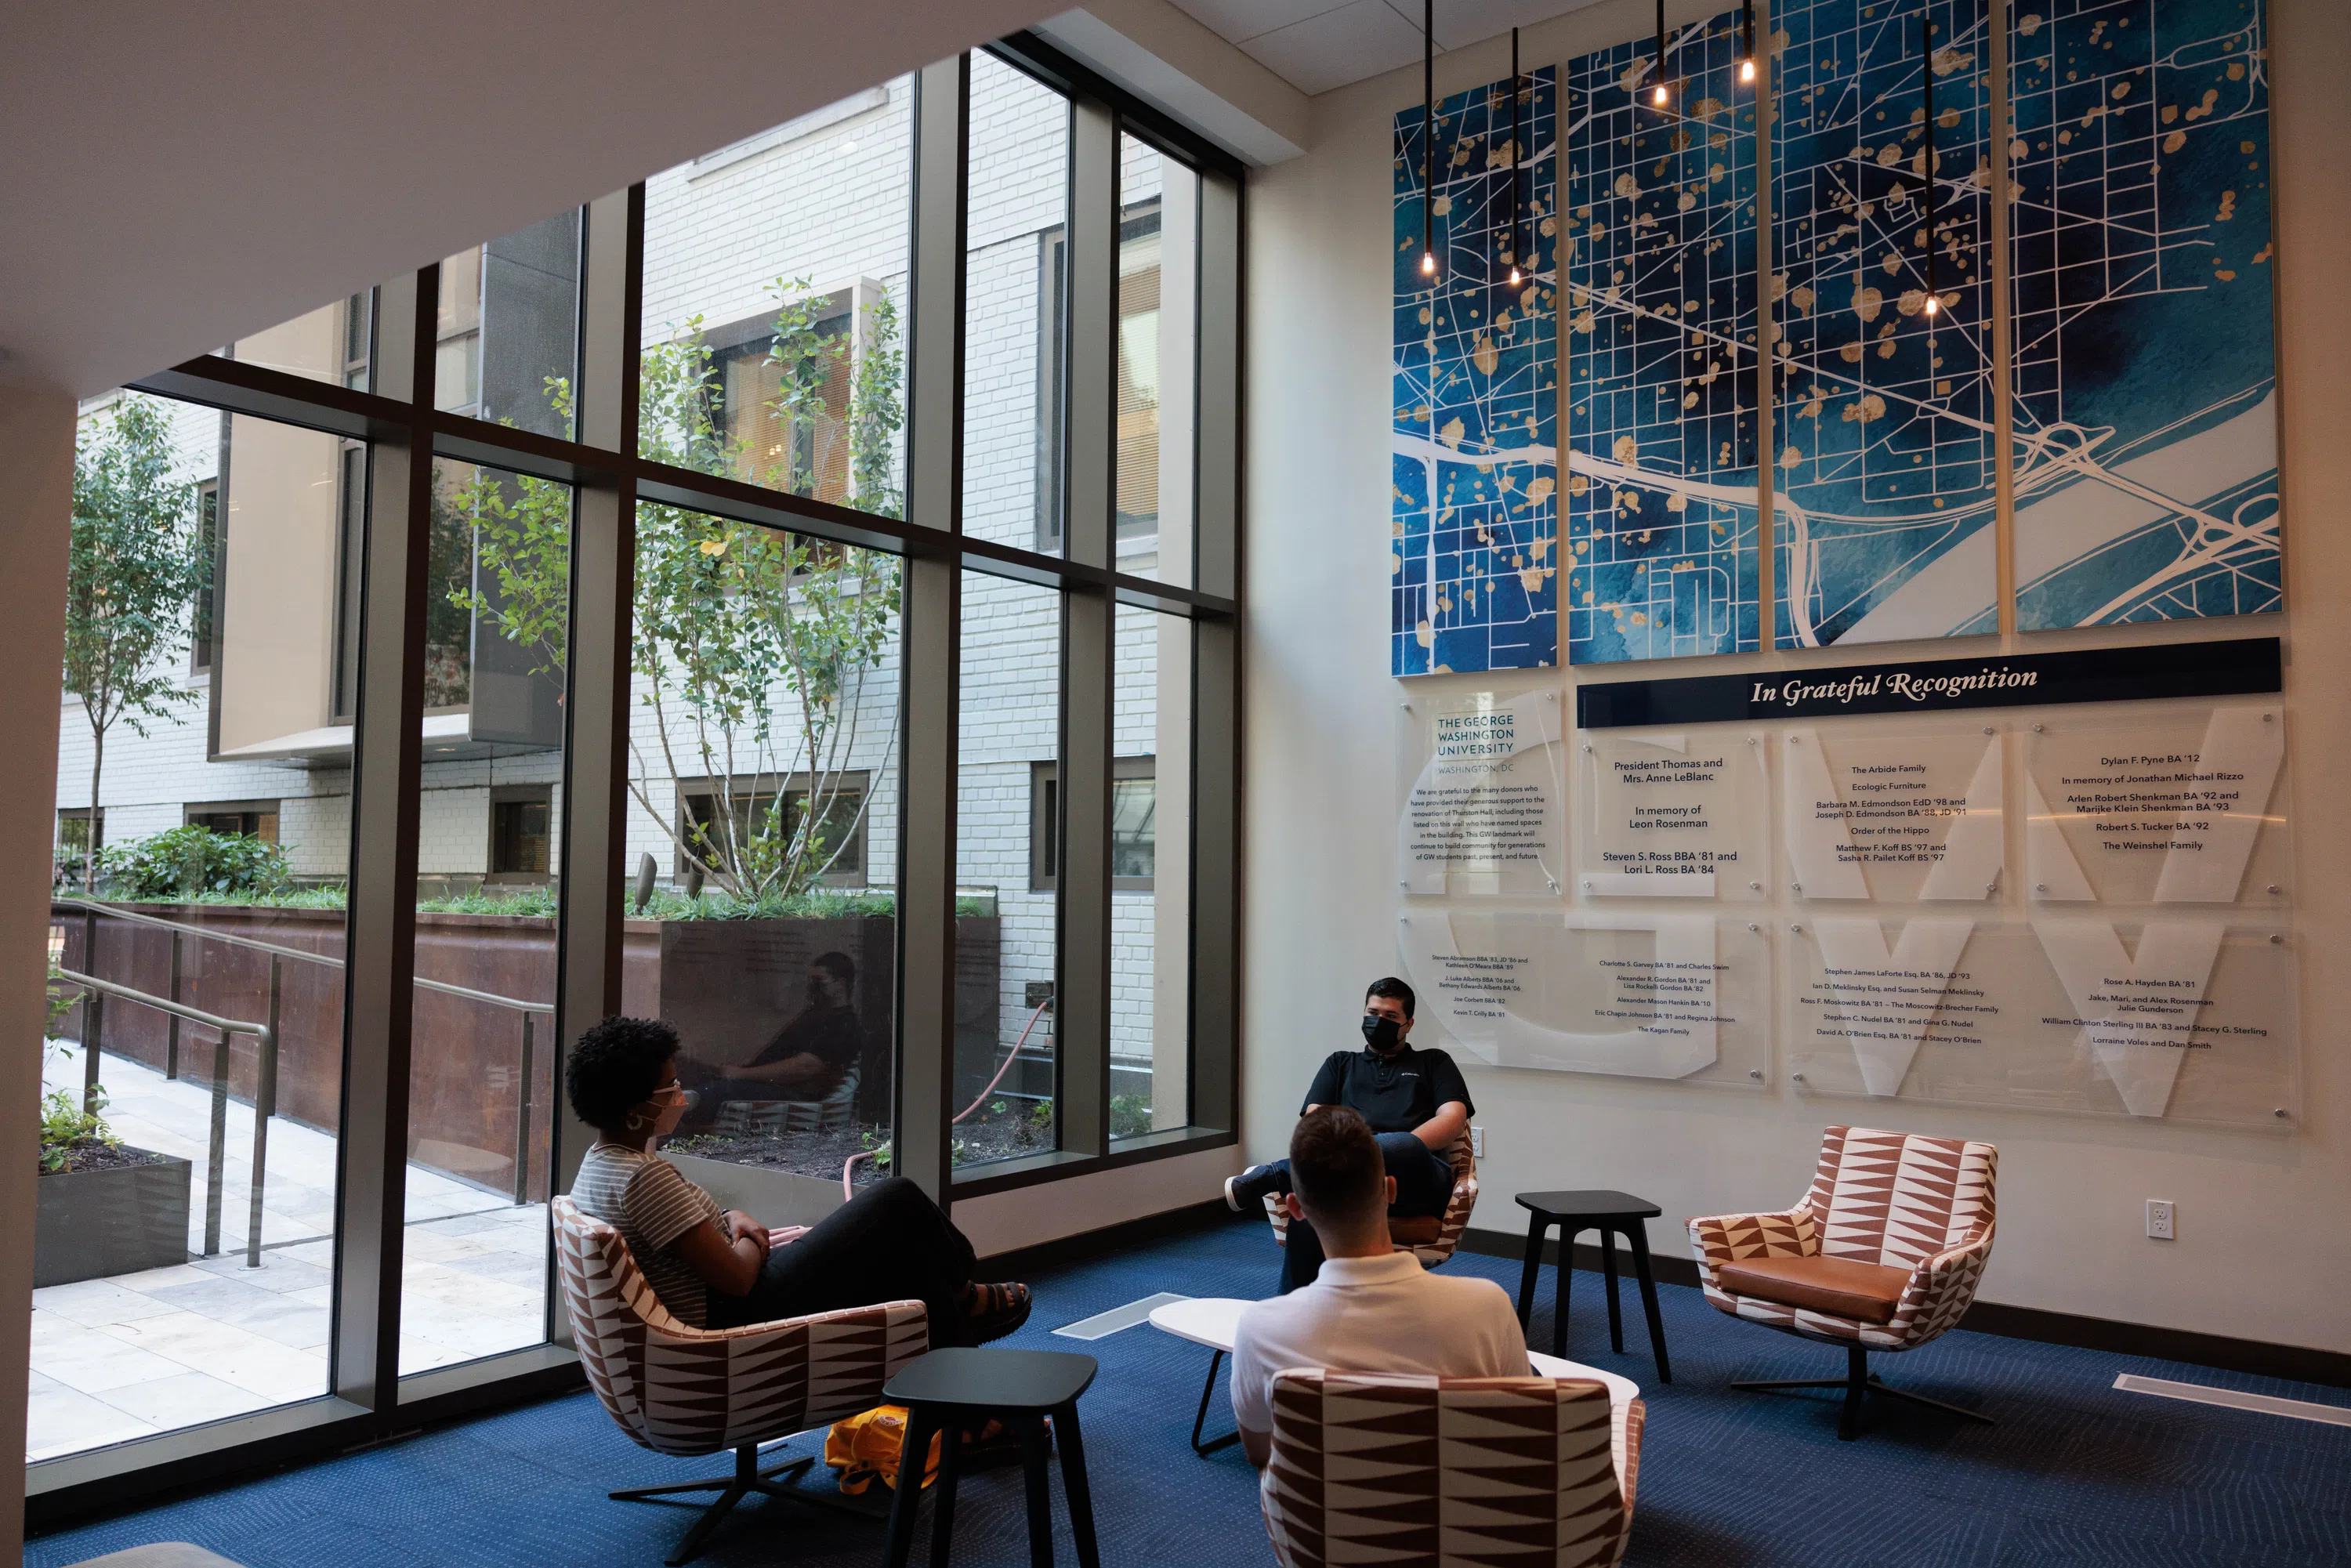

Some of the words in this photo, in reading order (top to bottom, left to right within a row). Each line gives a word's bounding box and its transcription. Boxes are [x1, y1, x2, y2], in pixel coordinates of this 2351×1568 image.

[1751, 683, 1777, 702] In
[1783, 675, 1882, 707] Grateful
[1886, 667, 2038, 701] Recognition
[1438, 719, 1461, 728] THE
[1464, 715, 1513, 727] GEORGE
[1438, 729, 1514, 742] WASHINGTON
[1439, 743, 1513, 756] UNIVERSITY
[1615, 761, 1660, 771] President
[1661, 760, 1701, 769] Thomas
[1704, 758, 1722, 768] and
[2101, 757, 2128, 767] Dylan
[2141, 756, 2164, 766] Pyne
[1439, 765, 1498, 774] WASHINGTON,
[1899, 765, 1926, 773] Family
[1624, 774, 1644, 783] Mrs.
[1646, 774, 1672, 783] Anne
[1675, 772, 1714, 782] LeBlanc
[2114, 775, 2125, 784] of
[2127, 774, 2172, 783] Jonathan
[2175, 773, 2214, 781] Michael
[1853, 784, 1887, 792] Ecologic
[2095, 794, 2127, 802] Robert
[2130, 793, 2181, 802] Shenkman
[2219, 791, 2239, 800] and
[1862, 799, 1911, 808] Edmondson
[1647, 808, 1689, 817] memory
[1691, 805, 1701, 814] of
[1816, 811, 1844, 820] Joseph
[1857, 809, 1905, 818] Edmondson
[2077, 805, 2112, 815] Marijke
[2142, 804, 2193, 813] Shenkman
[1630, 820, 1653, 828] Leon
[1656, 820, 1708, 828] Rosenman
[1904, 827, 1930, 836] Hippo
[1508, 842, 1546, 850] generations
[2171, 841, 2203, 851] Family
[1603, 853, 1636, 861] Steven
[1639, 852, 1646, 861] S.
[1650, 852, 1672, 861] Ross
[1675, 852, 1697, 861] BBA
[1718, 851, 1737, 861] and
[1625, 865, 1643, 874] Lori
[1646, 865, 1654, 874] L.
[1656, 865, 1679, 874] Ross
[1681, 865, 1696, 874] BA
[2135, 980, 2167, 988] Hayden
[2139, 1005, 2184, 1014] Gunderson
[1670, 1028, 1690, 1037] Family
[2103, 1020, 2134, 1030] Sterling
[2193, 1025, 2220, 1034] Stacey
[2234, 1027, 2267, 1037] Sterling
